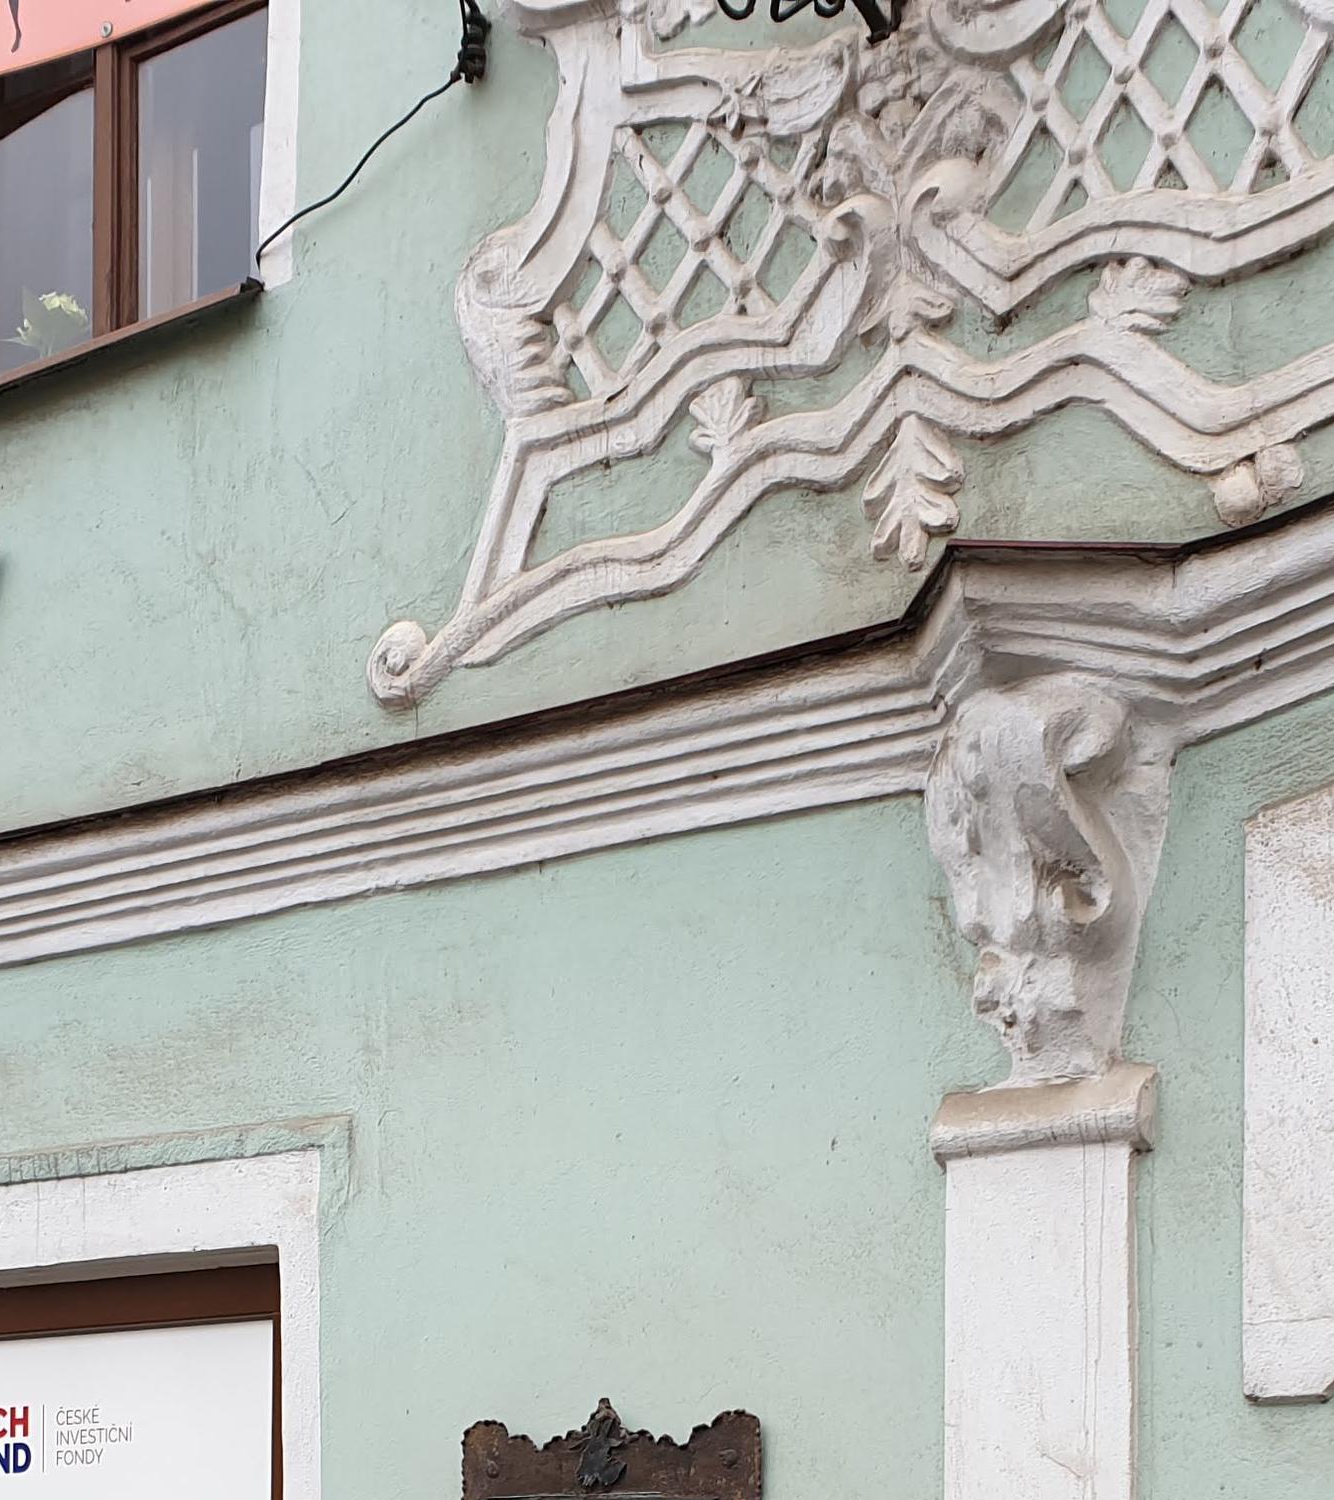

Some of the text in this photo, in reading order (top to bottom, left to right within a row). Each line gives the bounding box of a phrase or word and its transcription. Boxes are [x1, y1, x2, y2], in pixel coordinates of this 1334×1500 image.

[56, 1404, 100, 1426] ČESKÉ
[56, 1421, 133, 1447] INVESTIČNÍ
[56, 1447, 104, 1467] FONDY
